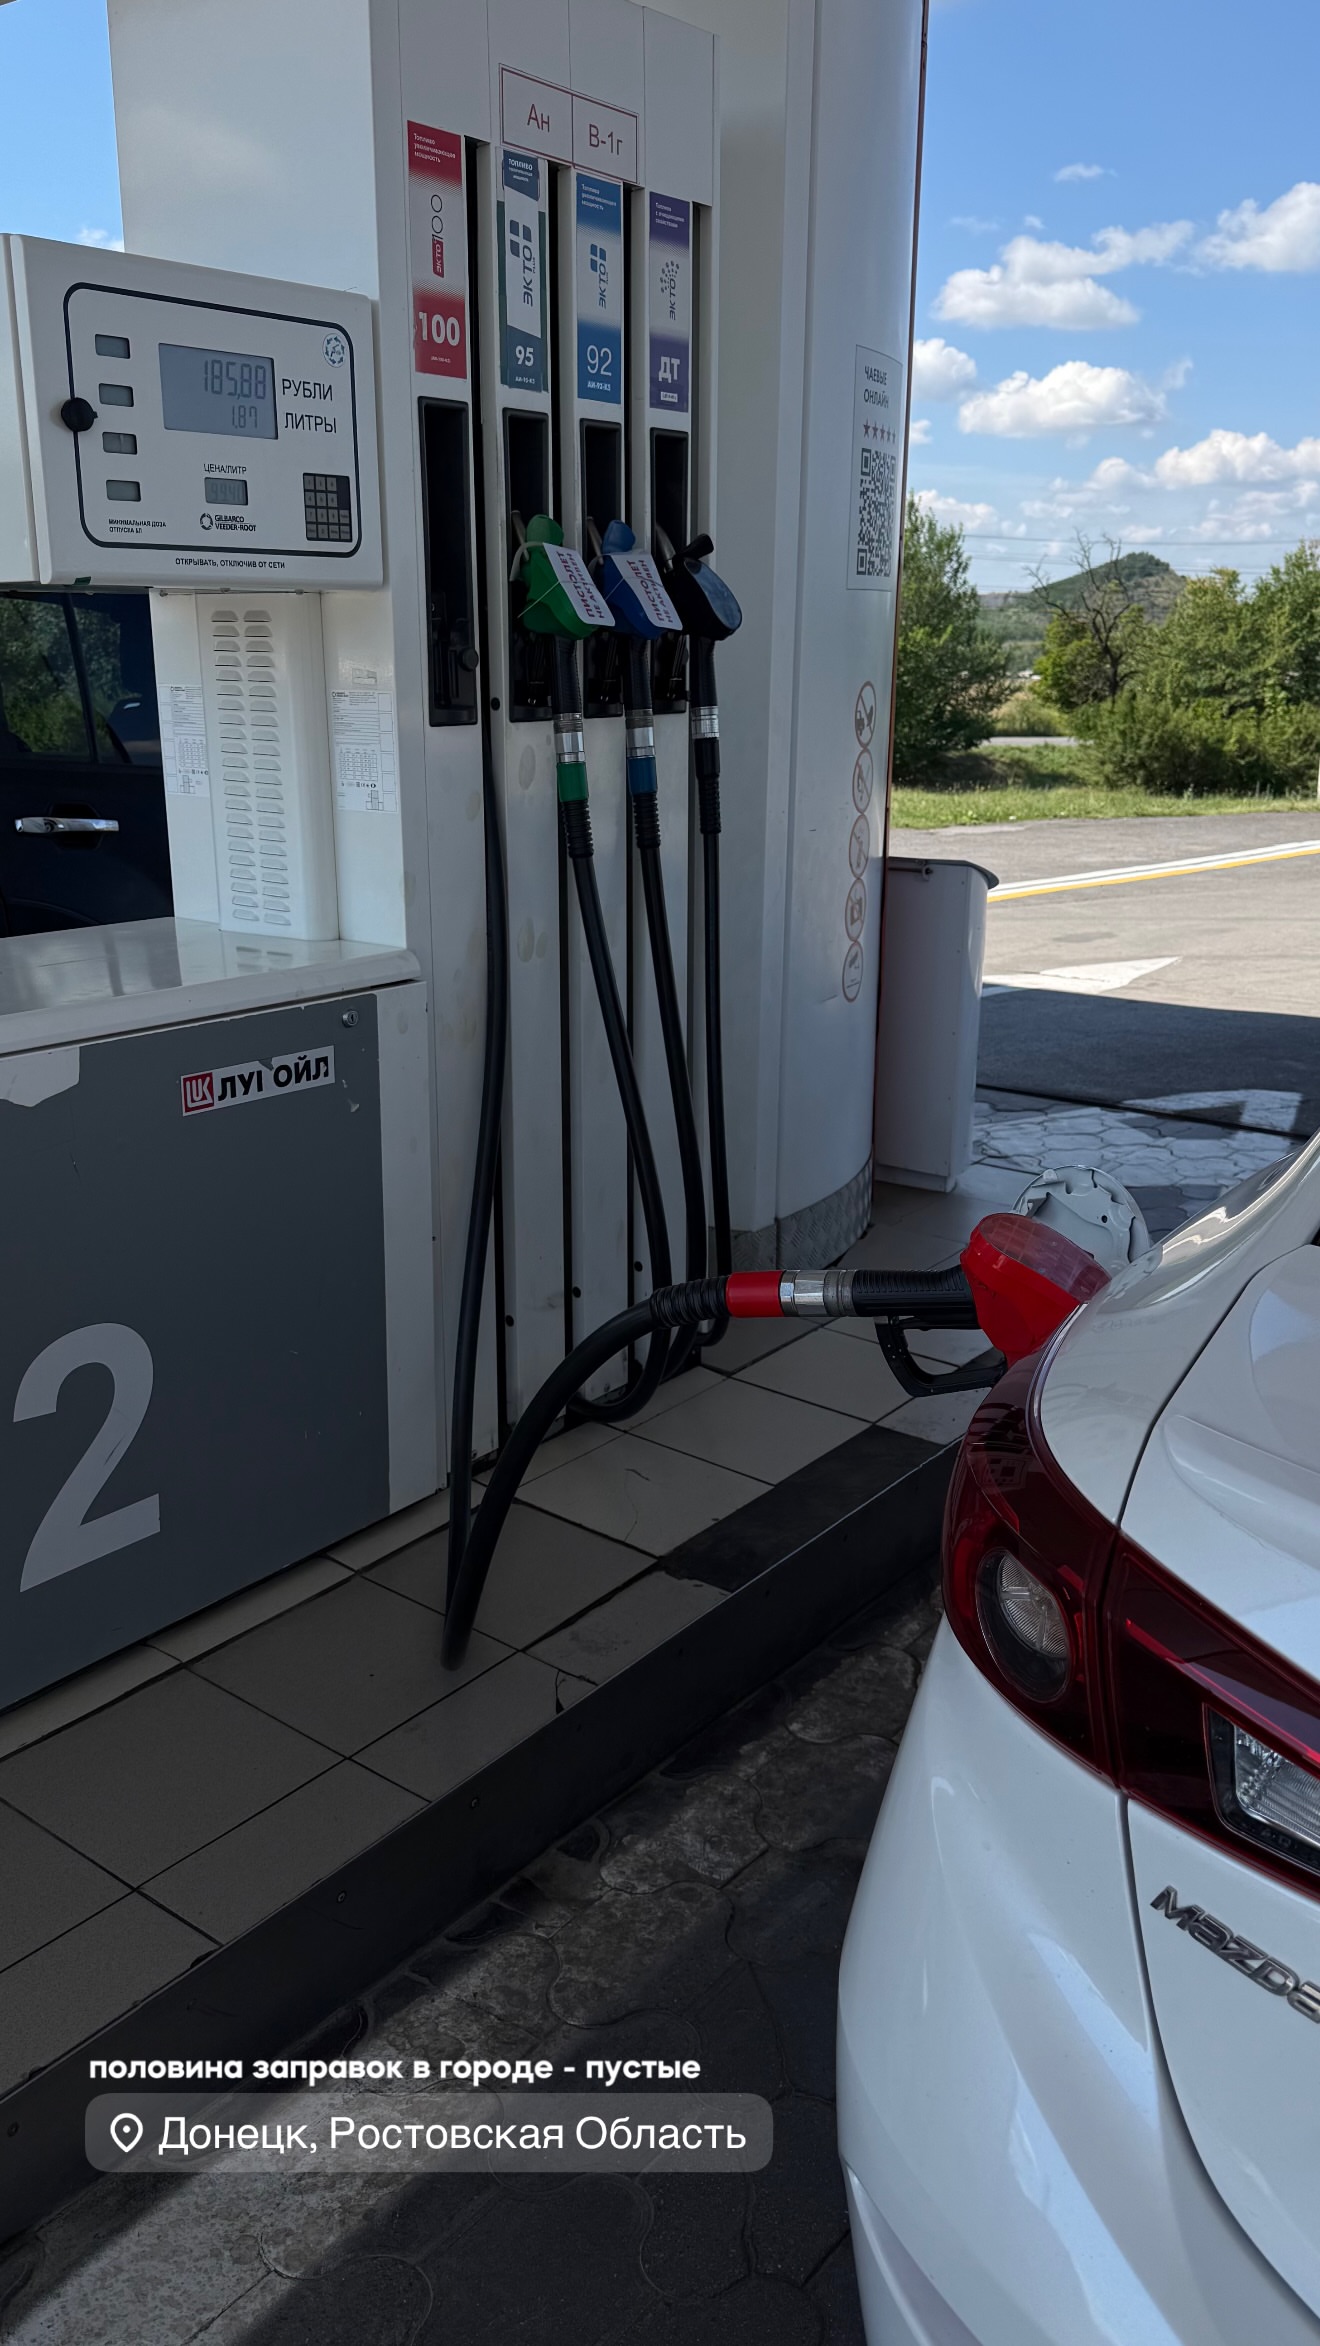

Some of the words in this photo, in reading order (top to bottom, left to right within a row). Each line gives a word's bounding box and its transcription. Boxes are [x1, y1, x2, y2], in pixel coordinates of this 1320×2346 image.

[522, 244, 533, 307] ЭКТО
[598, 262, 607, 309] ЭКТО
[418, 311, 460, 347] 100
[515, 345, 535, 367] 95
[586, 344, 613, 377] 92
[658, 356, 681, 384] ДТ
[281, 378, 333, 401] РУБЛИ
[864, 365, 888, 387] ЧАЕВЫЕ
[863, 387, 889, 409] ОНЛАЙН
[284, 412, 337, 434] ЛИТРЫ
[175, 557, 219, 568] ОТКРЫВАТЬ,
[219, 559, 257, 569] ОТКЛЮЧИВ
[258, 560, 267, 569] ОТ
[268, 561, 286, 569] СЕТИ
[557, 551, 595, 618] ПИСТОЛЕТ
[627, 559, 665, 622] ПИСТОЛЕТ
[13, 1322, 161, 1592] 2
